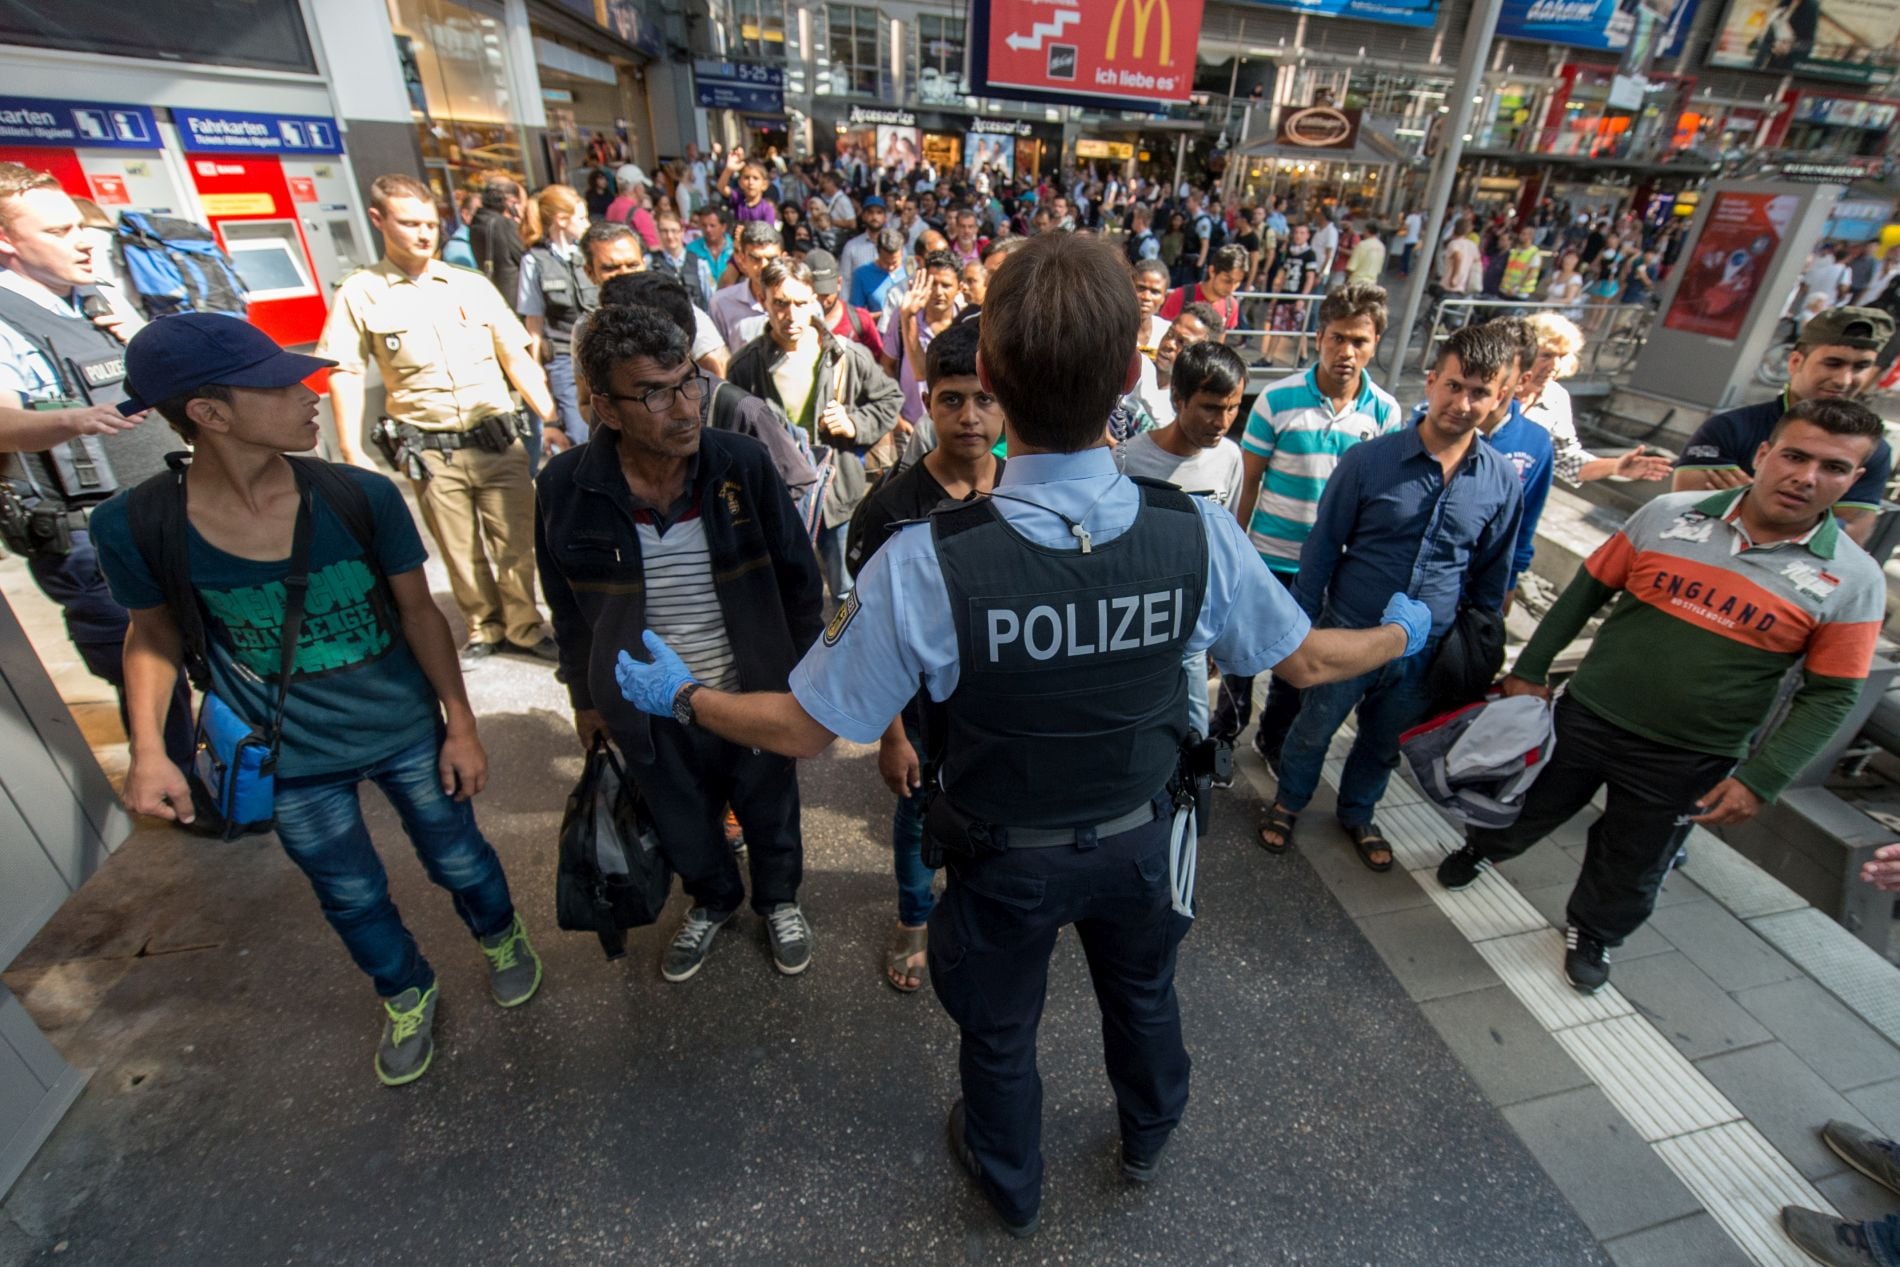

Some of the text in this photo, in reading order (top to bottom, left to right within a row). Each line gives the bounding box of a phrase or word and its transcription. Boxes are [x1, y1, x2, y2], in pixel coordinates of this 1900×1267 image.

[1096, 67, 1116, 84] ich
[1119, 71, 1153, 88] liebe
[187, 117, 269, 136] Fahrkarten
[85, 359, 127, 381] POLIZE
[1652, 571, 1777, 632] ENGLAND
[1670, 597, 1737, 629] NO STYLE NO LIFE
[228, 602, 376, 648] CHALENGE
[987, 588, 1183, 662] POLIZEI
